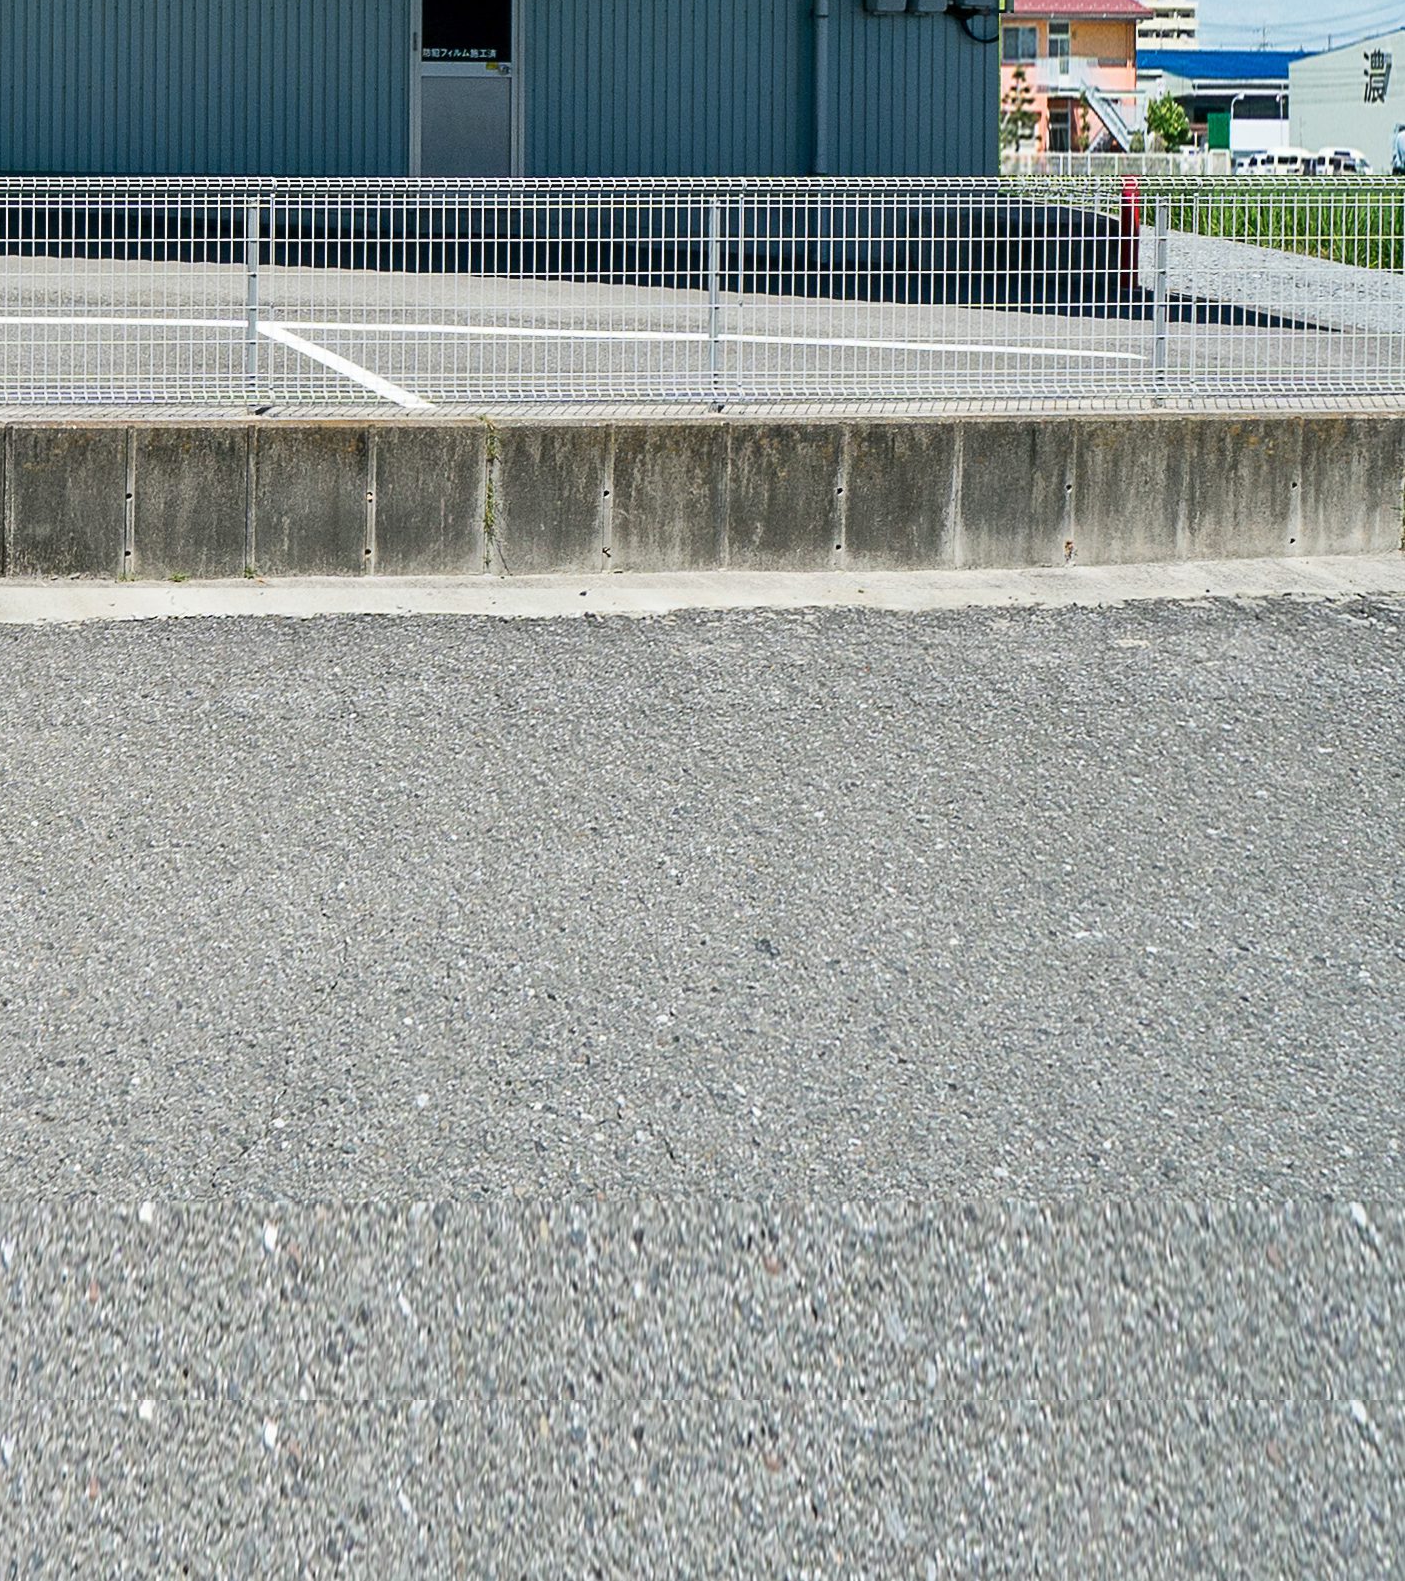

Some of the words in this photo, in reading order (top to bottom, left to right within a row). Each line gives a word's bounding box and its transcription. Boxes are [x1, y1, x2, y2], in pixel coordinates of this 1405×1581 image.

[422, 48, 497, 59] 防犯フィルム施工済
